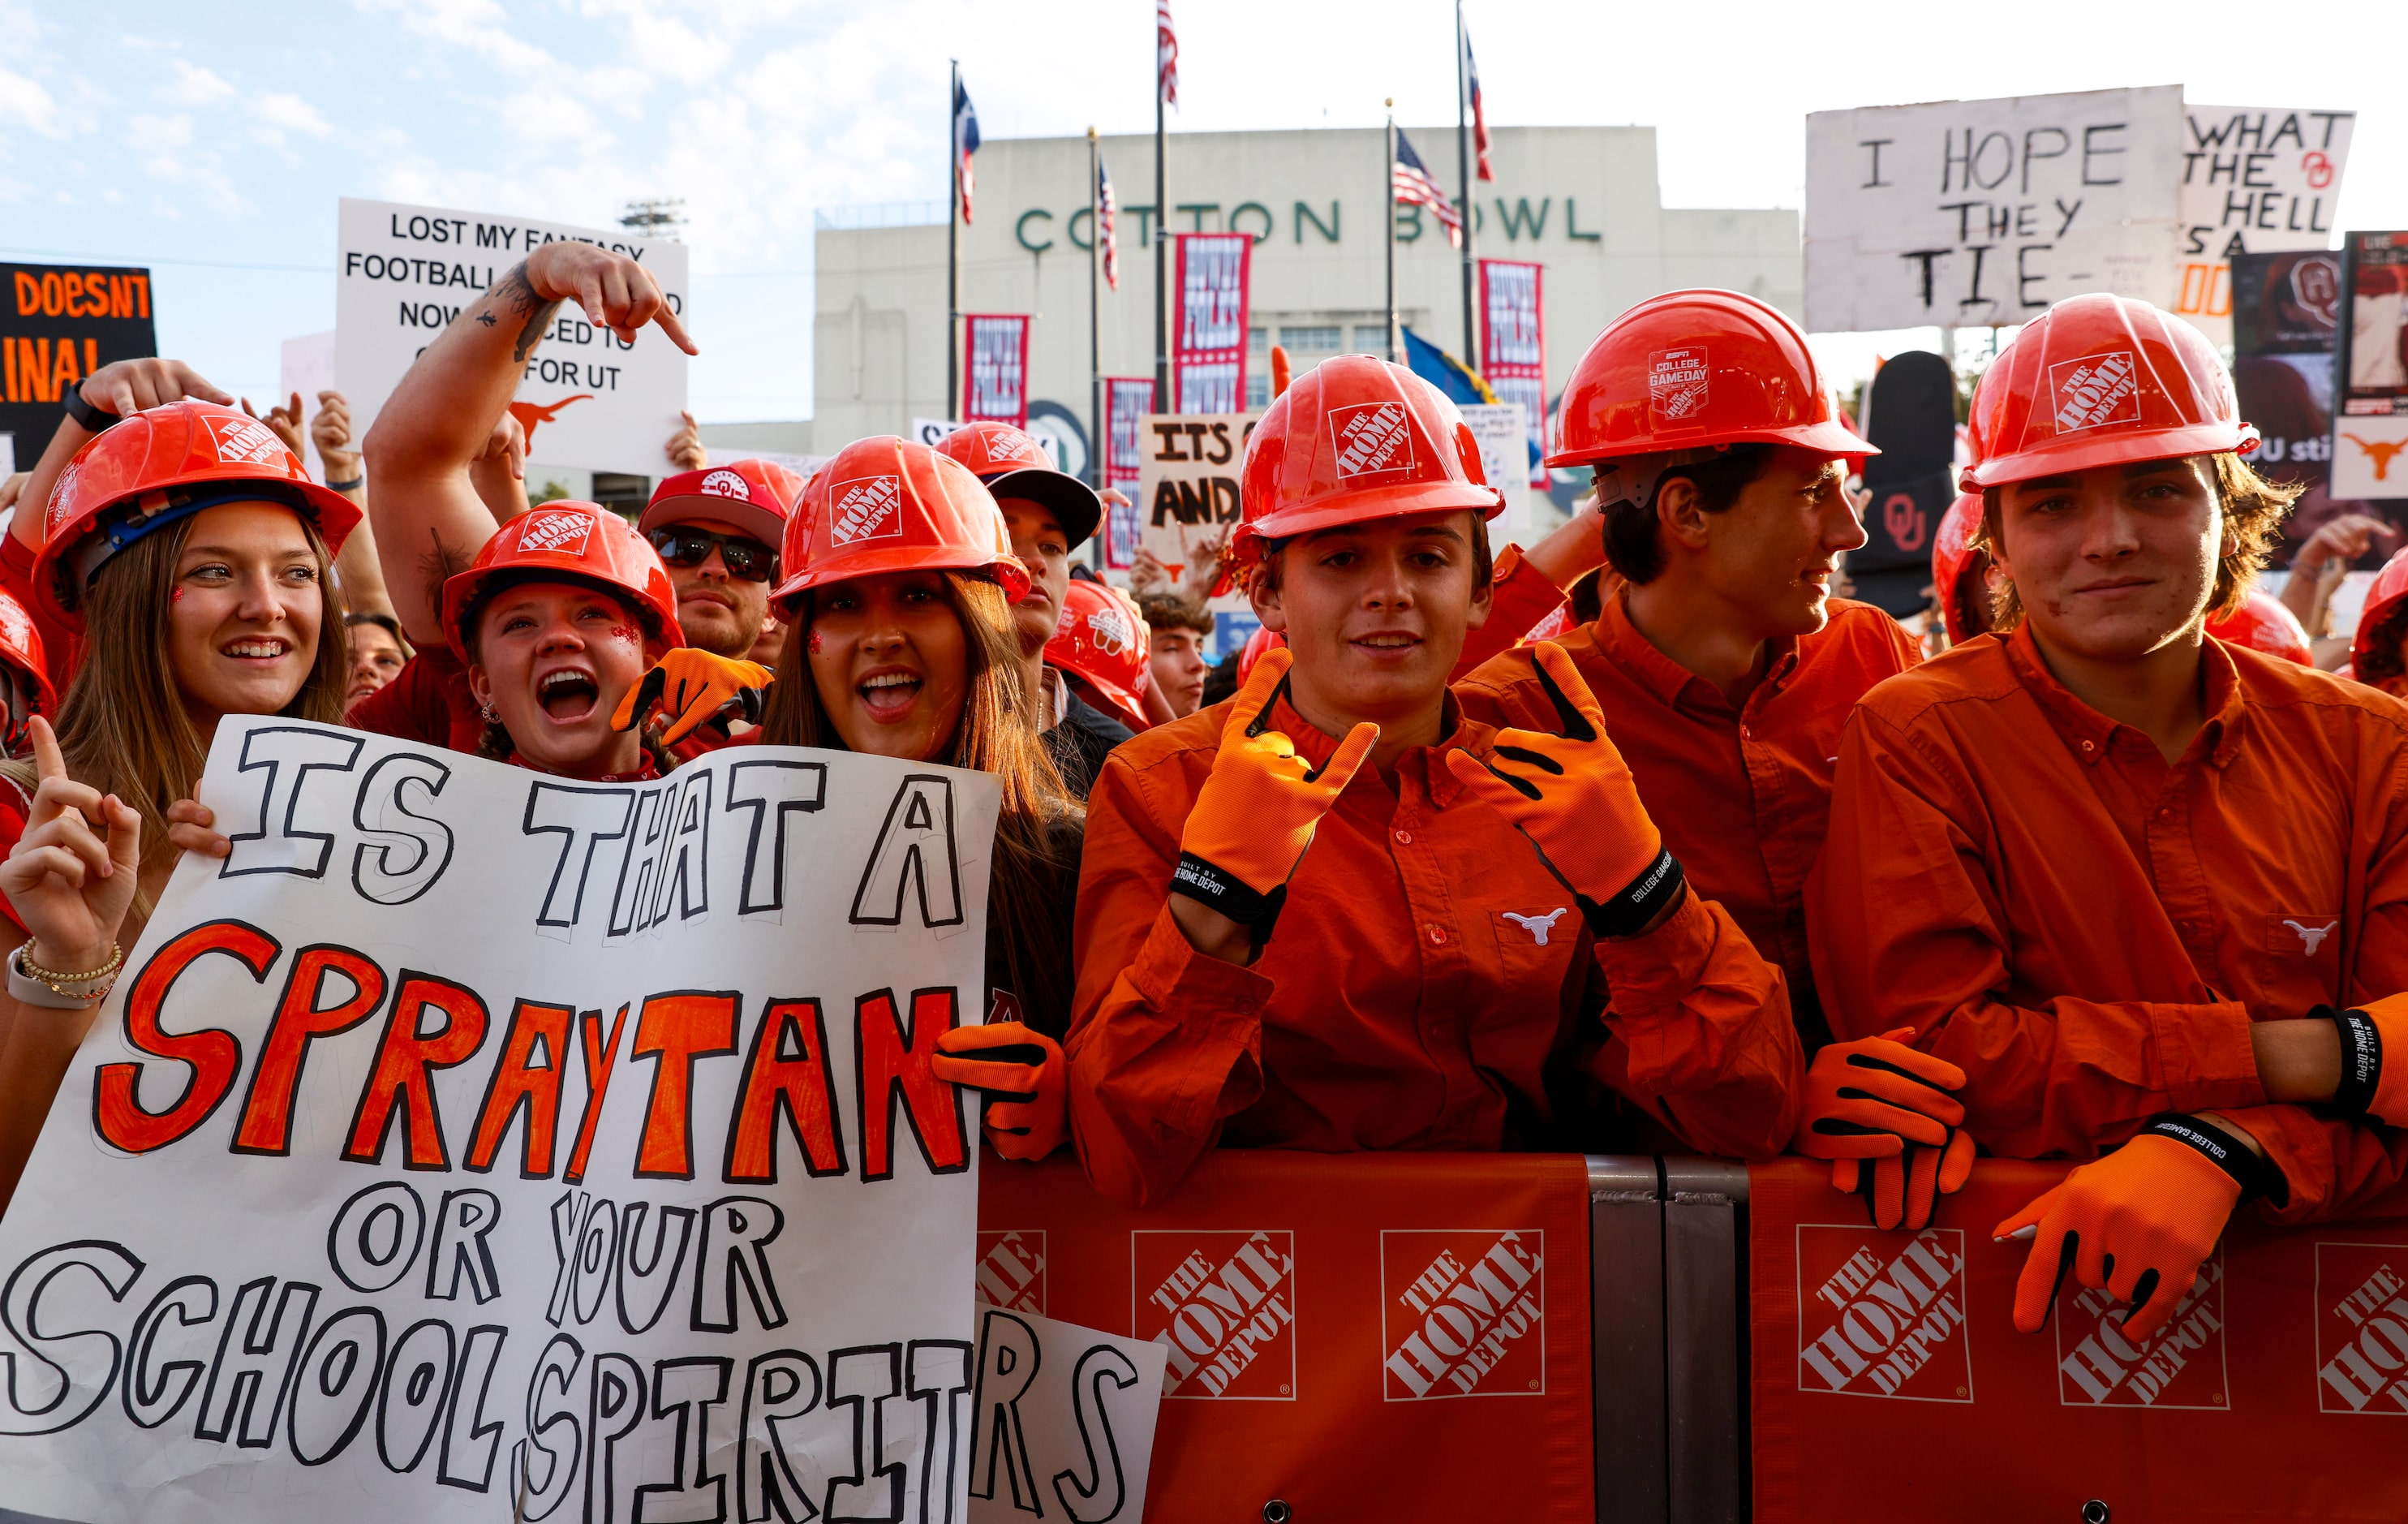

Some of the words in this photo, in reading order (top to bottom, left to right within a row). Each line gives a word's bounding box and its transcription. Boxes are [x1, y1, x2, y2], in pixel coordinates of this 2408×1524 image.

[2187, 112, 2354, 149] WHAT
[1859, 139, 1894, 189] I
[1940, 123, 2128, 195] HOPE
[2182, 152, 2277, 187] THE
[1937, 198, 2083, 243] THEY
[2222, 190, 2328, 232] HELL
[391, 213, 467, 245] LOST
[475, 222, 518, 252] MY
[587, 364, 621, 390] UT
[1649, 369, 1708, 387] GAMEDAY
[1656, 359, 1700, 372] COLLEGE
[2060, 364, 2094, 394] THE
[2057, 353, 2133, 430] HOME
[2088, 376, 2135, 425] DEPOT
[218, 420, 245, 437] THE
[219, 422, 274, 461] HOME
[1338, 403, 1405, 475] HOME
[1340, 411, 1370, 440] THE
[1367, 424, 1409, 471] DEPOT
[832, 476, 900, 543] HOME
[836, 484, 864, 511] THE
[858, 496, 899, 539] DEPOT
[1150, 477, 1241, 529] AND
[522, 514, 591, 549] HOME
[532, 513, 561, 528] THE
[544, 527, 588, 550] DEPOT
[219, 726, 454, 905] IS
[522, 759, 830, 937] THAT
[849, 773, 965, 928] A
[1179, 867, 1200, 885] HOME
[1197, 876, 1227, 896] DEPOT
[1180, 861, 1201, 872] BUILT
[1203, 869, 1216, 879] BY
[1632, 873, 1660, 903] COLLEGE
[2347, 1018, 2364, 1031] THE
[2353, 1028, 2368, 1053] HOME
[2363, 1026, 2376, 1053] BUILT
[2356, 1053, 2369, 1083] DEPOT
[2368, 1057, 2376, 1071] BY
[2189, 1131, 2227, 1159] COLLEGE
[327, 1180, 501, 1305] OR
[546, 1189, 787, 1336] YOUR
[1815, 1244, 1885, 1311] THE
[1149, 1248, 1215, 1315] THE
[1399, 1248, 1467, 1316] THE
[2333, 1263, 2406, 1328] THE
[1386, 1230, 1543, 1400] HOME
[1801, 1229, 1963, 1391] HOME
[1194, 1291, 1293, 1397] DEPOT
[1447, 1289, 1543, 1396] DEPOT
[1867, 1291, 1964, 1397] DEPOT
[2126, 1300, 2222, 1406] DEPOT
[0, 1238, 508, 1493] SCHOOL
